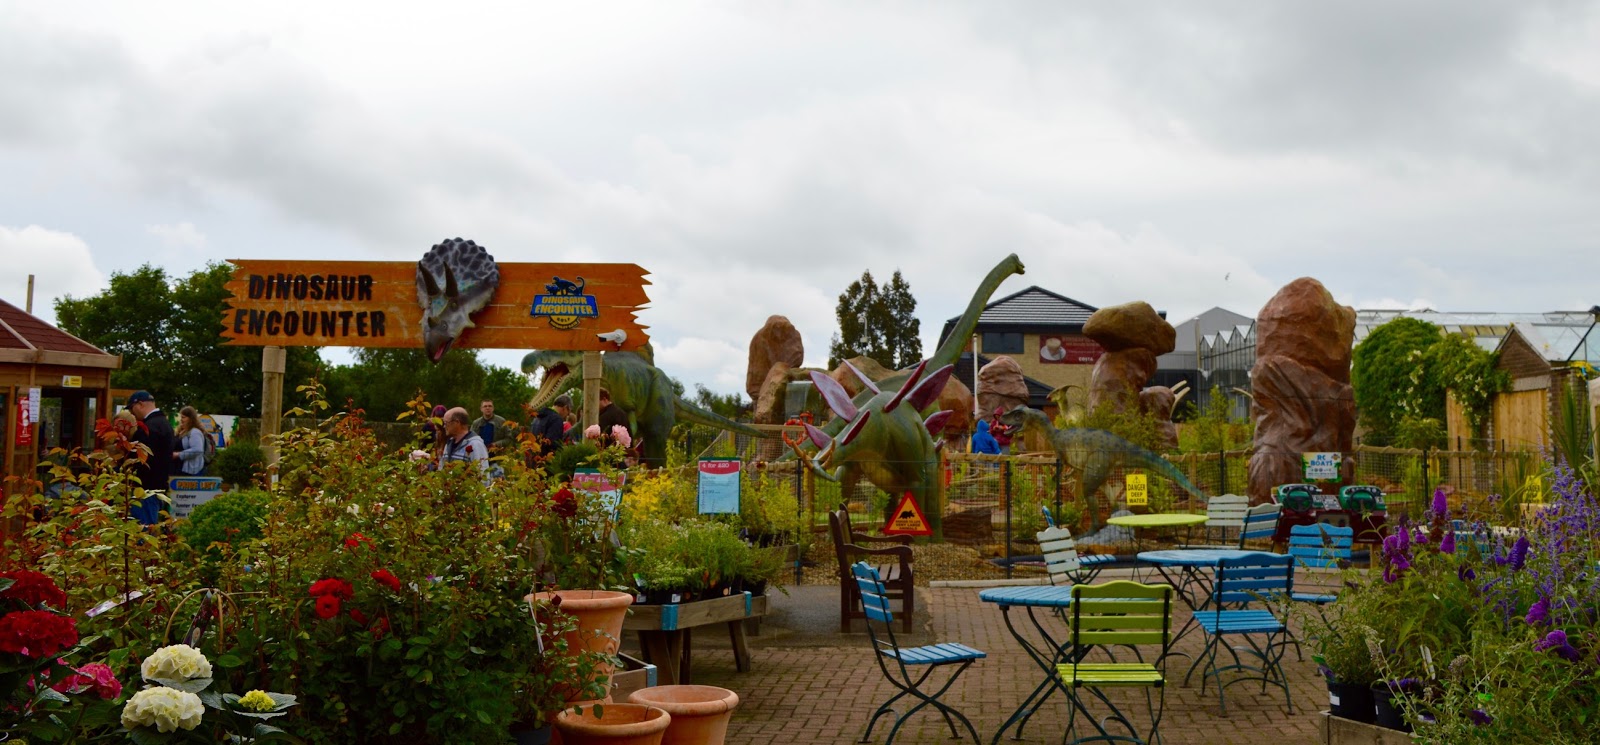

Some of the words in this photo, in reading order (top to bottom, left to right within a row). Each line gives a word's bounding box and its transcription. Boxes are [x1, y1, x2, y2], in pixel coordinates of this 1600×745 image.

[248, 273, 373, 301] DINOSAUR
[542, 296, 587, 304] DINOSAUR
[535, 304, 593, 314] ENCOUNTER
[233, 308, 386, 338] ENCOUNTER
[176, 480, 198, 490] PRICE
[200, 481, 217, 490] LIST
